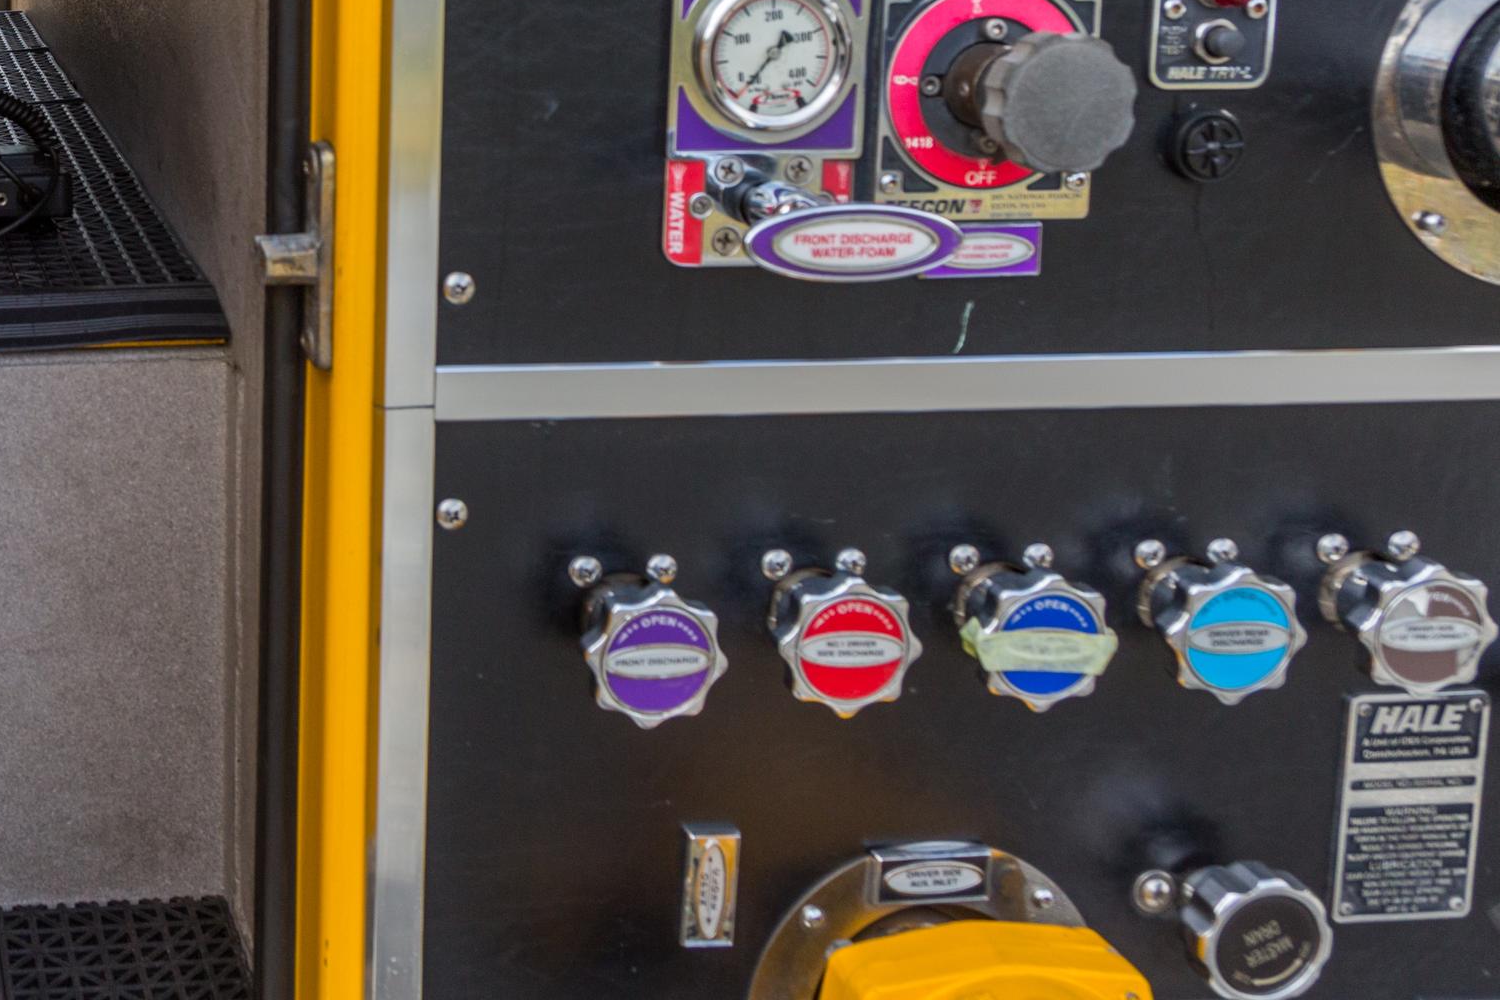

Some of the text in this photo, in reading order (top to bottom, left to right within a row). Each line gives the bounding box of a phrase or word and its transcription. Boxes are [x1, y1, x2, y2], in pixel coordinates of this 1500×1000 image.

[765, 9, 783, 22] 200
[734, 34, 750, 45] 100
[1167, 66, 1207, 80] HALE
[964, 171, 997, 185] OFF
[668, 192, 686, 254] WATER
[794, 232, 913, 245] FRONT DISCHARGE
[811, 247, 896, 258] WATER-FOAM
[836, 602, 874, 615] OPEN
[1034, 599, 1070, 612] OPEN
[640, 614, 677, 628] OPEN
[1370, 703, 1467, 734] HALE
